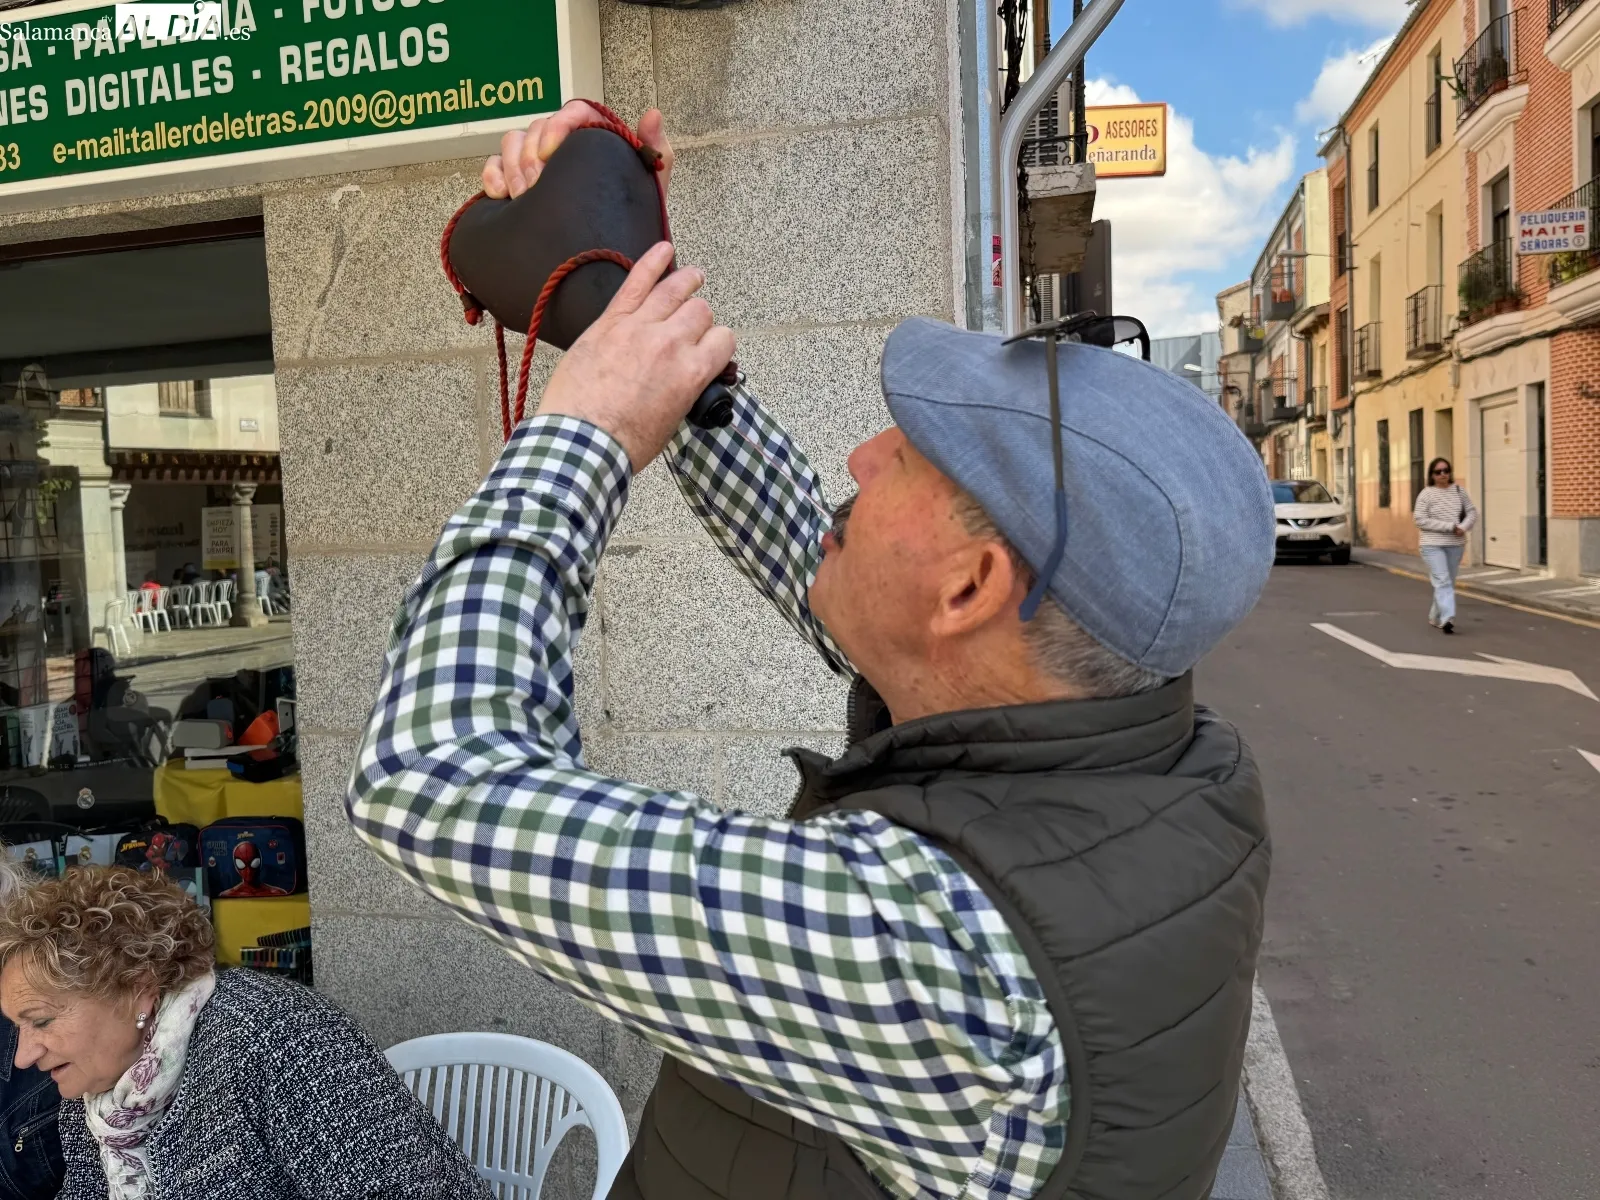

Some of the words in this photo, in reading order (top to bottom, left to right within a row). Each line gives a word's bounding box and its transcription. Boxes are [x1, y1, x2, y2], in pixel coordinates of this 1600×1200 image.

[65, 55, 235, 116] DIGITALES
[279, 22, 450, 84] REGALOS
[53, 76, 544, 164] e-mail:tallerdeletras.2009@gmail.com
[1105, 118, 1158, 139] ASESORES
[1088, 144, 1157, 163] eñaranda
[1520, 210, 1586, 226] PELUQUERIA
[1521, 224, 1585, 238] MAITE
[1520, 238, 1569, 252] SEÑORAS
[211, 540, 229, 548] PARA
